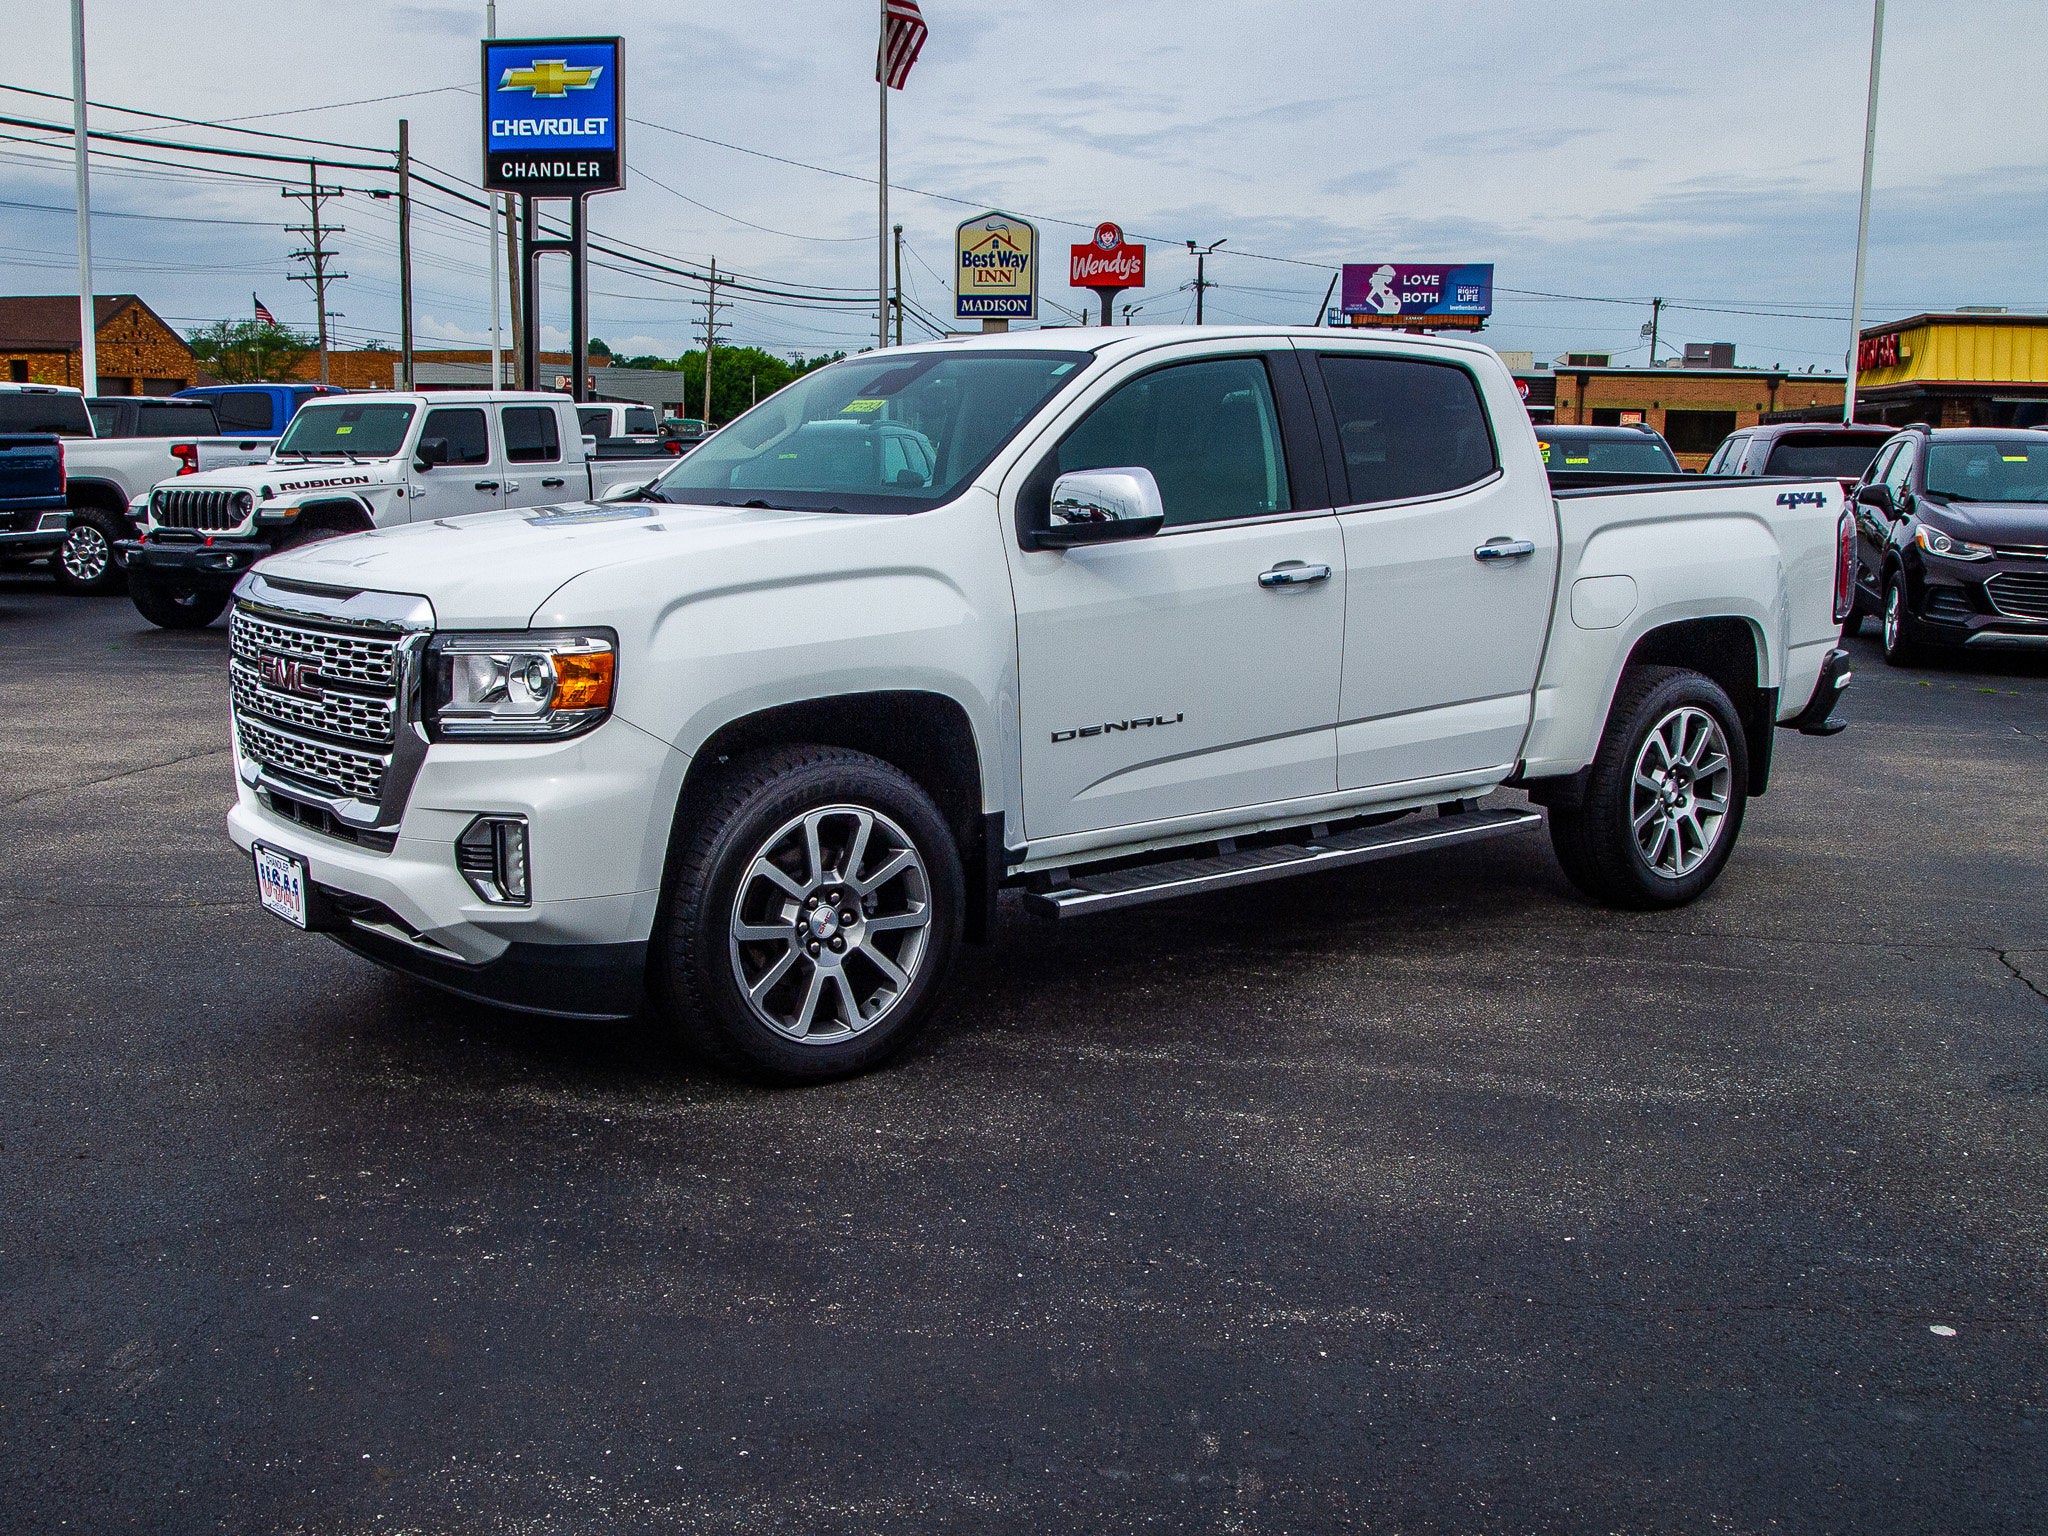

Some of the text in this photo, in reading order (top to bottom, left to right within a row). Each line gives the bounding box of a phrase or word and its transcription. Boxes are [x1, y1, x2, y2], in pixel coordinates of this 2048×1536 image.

[492, 117, 609, 137] CHEVROLET
[501, 161, 600, 178] CHANDLER
[962, 250, 1029, 273] Best Way
[1073, 251, 1141, 281] Wendy's
[976, 269, 1012, 283] INN
[1403, 274, 1440, 286] LOVE
[961, 300, 1028, 312] MADISON
[1402, 292, 1439, 303] BOTH
[1457, 294, 1479, 302] LIFE
[279, 475, 370, 491] RUBICON
[257, 654, 323, 697] GMC
[1051, 710, 1184, 744] DENALI
[817, 910, 833, 935] GMC
